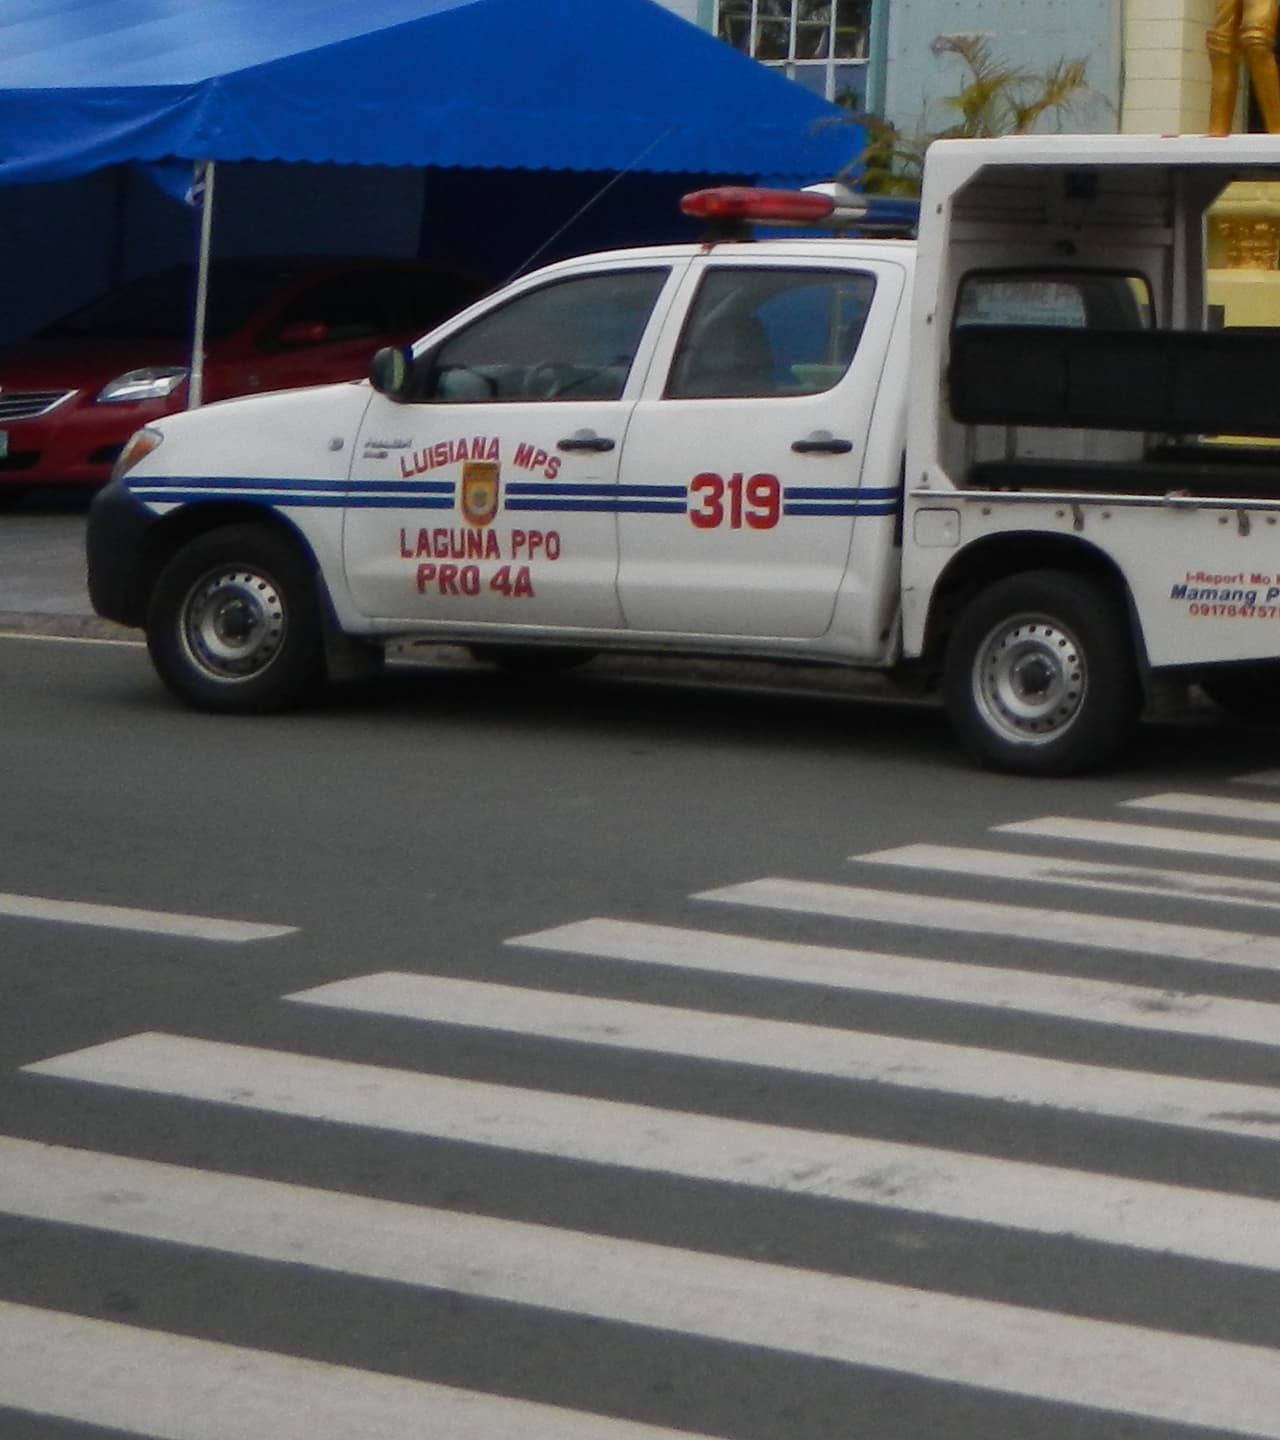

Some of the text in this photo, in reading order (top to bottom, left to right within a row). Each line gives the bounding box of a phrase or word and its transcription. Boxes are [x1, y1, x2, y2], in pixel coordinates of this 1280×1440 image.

[400, 436, 562, 479] LUISIANA MPS
[689, 472, 781, 530] 319
[400, 528, 561, 560] LAGUNA PPO
[416, 563, 534, 598] PRO 4A
[1170, 584, 1257, 604] Mamang
[1250, 573, 1271, 585] Mo
